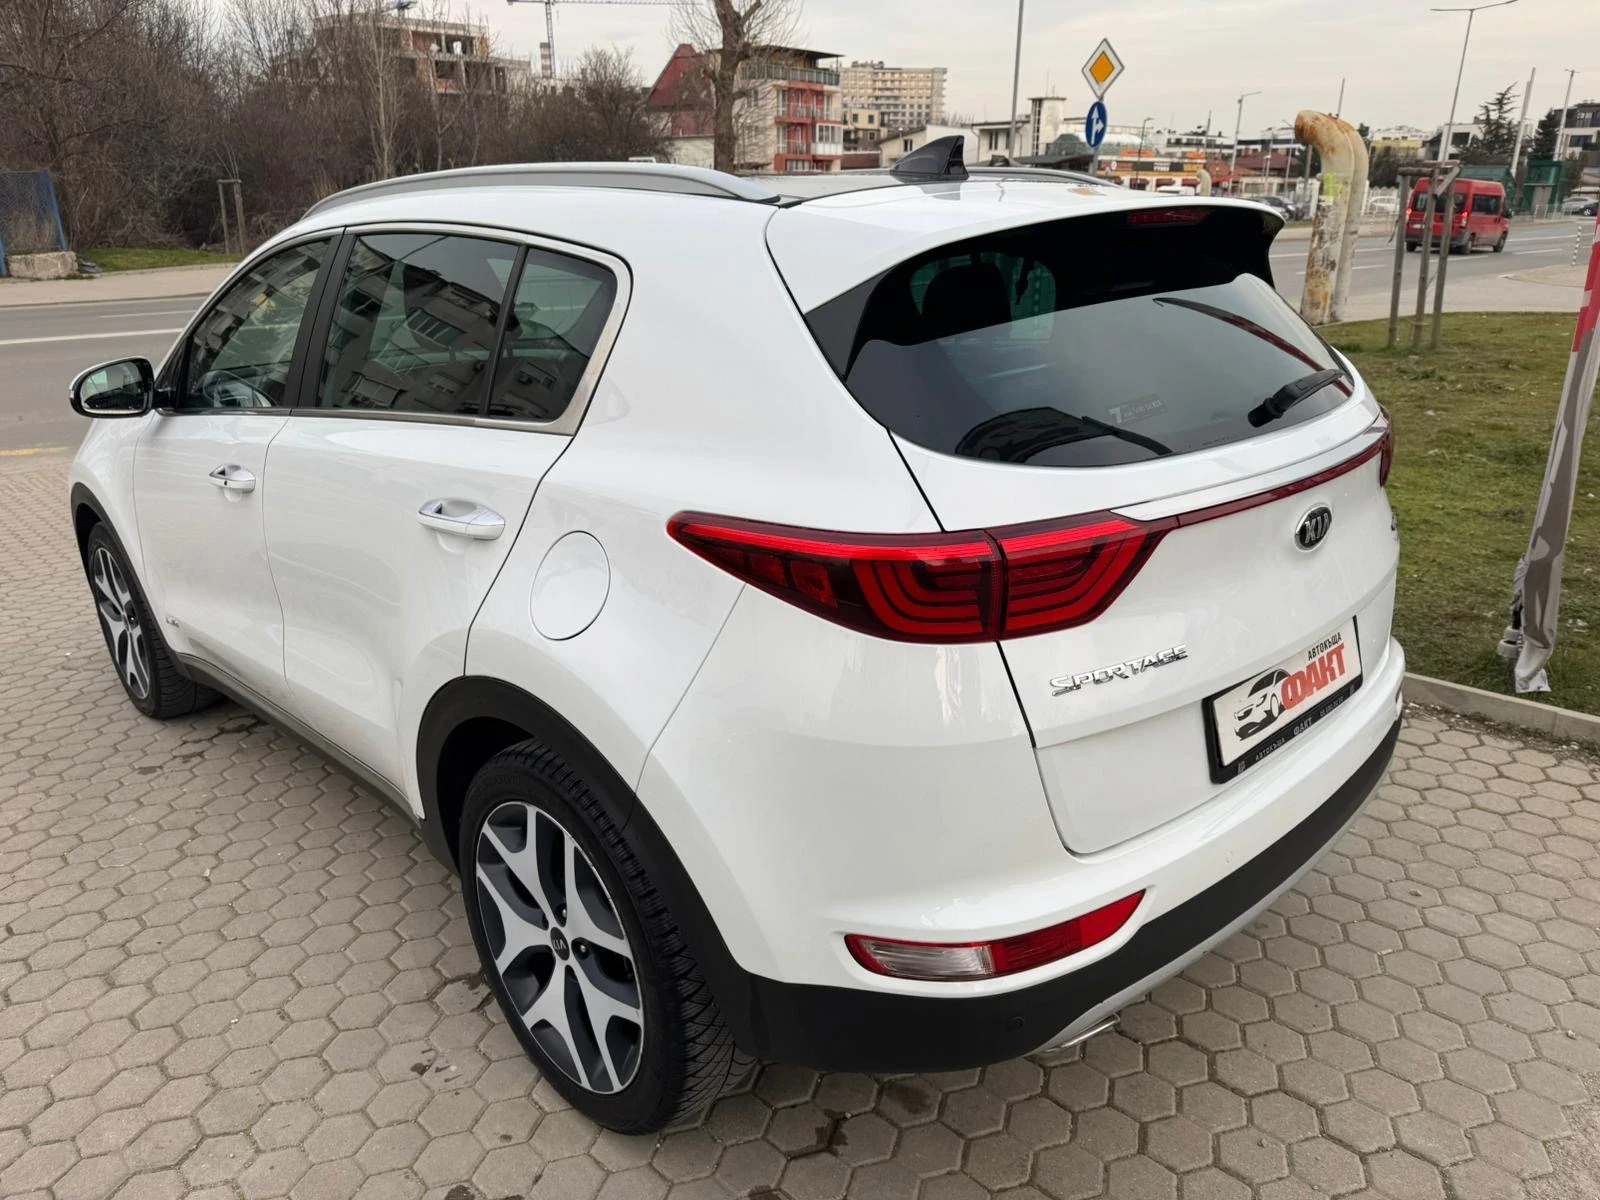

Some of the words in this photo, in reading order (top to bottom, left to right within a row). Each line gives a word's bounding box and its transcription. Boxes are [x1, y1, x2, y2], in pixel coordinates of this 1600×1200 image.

[1304, 512, 1330, 544] KIA
[1307, 632, 1342, 661] АВТОКЪЩА
[1050, 644, 1188, 697] SPORTAGE
[1281, 642, 1346, 710] ФАКТ
[1293, 717, 1313, 736] ФАКТ
